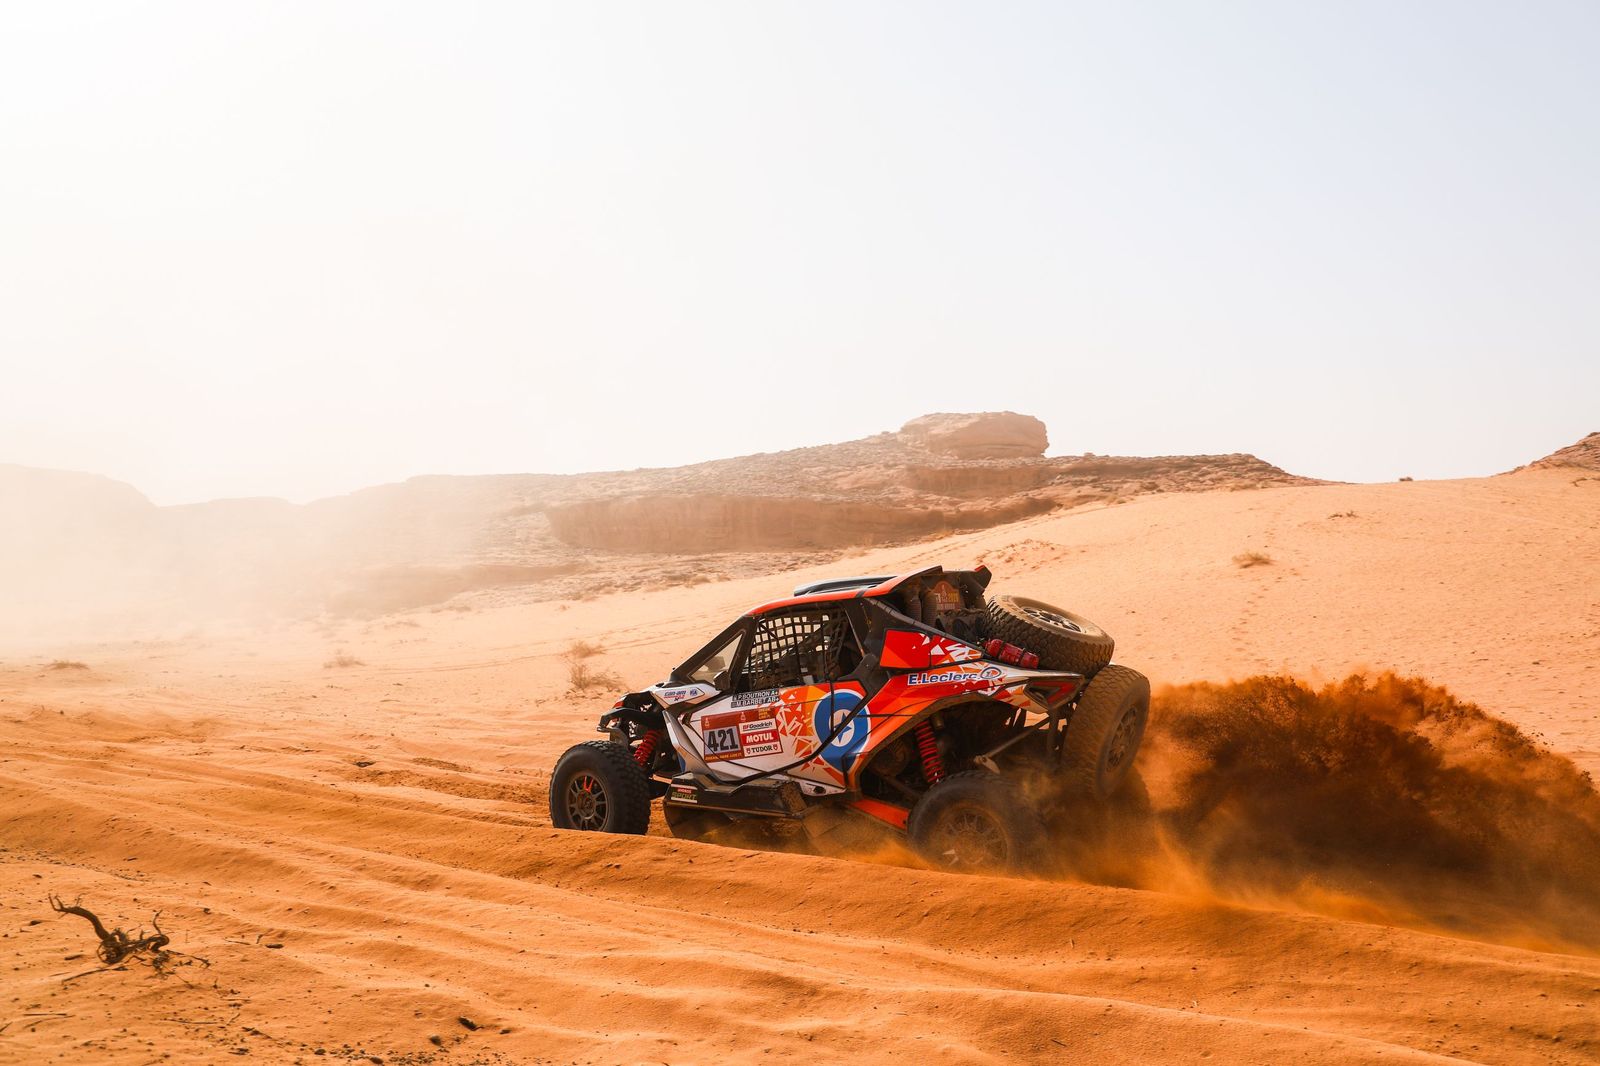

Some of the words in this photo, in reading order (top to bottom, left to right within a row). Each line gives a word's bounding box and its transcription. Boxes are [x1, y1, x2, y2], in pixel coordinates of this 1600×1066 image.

[908, 672, 978, 685] E.Leclerc
[707, 728, 739, 752] 421
[746, 732, 774, 743] MOTUL
[751, 745, 773, 753] TUDOR
